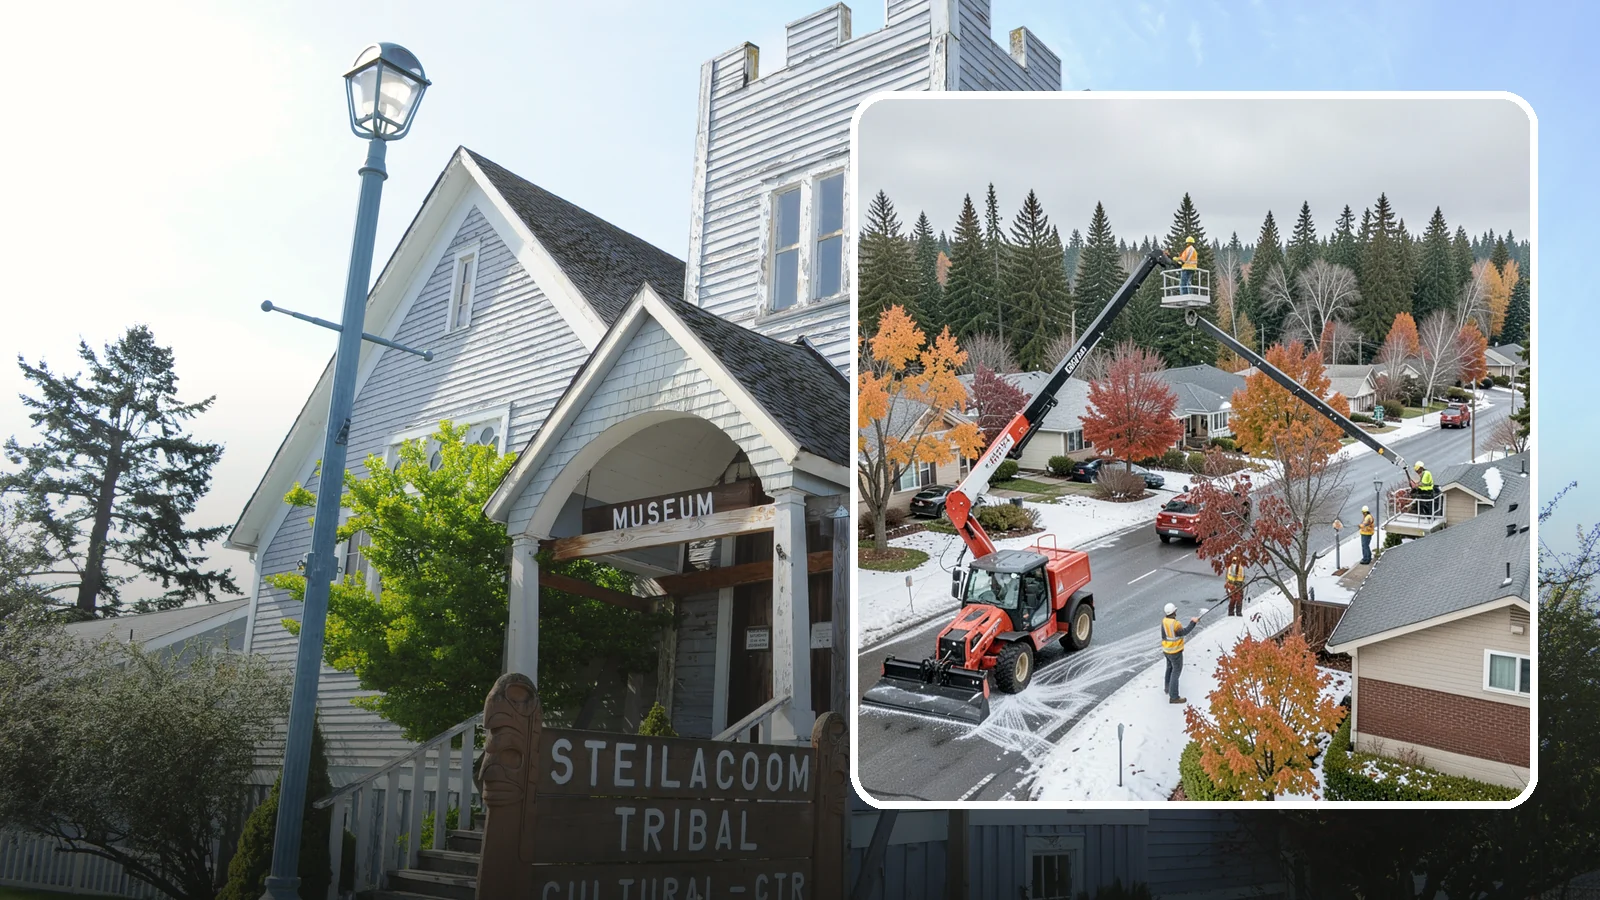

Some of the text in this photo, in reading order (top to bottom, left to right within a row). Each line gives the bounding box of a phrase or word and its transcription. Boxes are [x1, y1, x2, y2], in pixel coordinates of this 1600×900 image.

[612, 491, 714, 530] MUSEUM
[550, 738, 809, 792] STEILACOOM
[615, 807, 757, 852] TRIBAL
